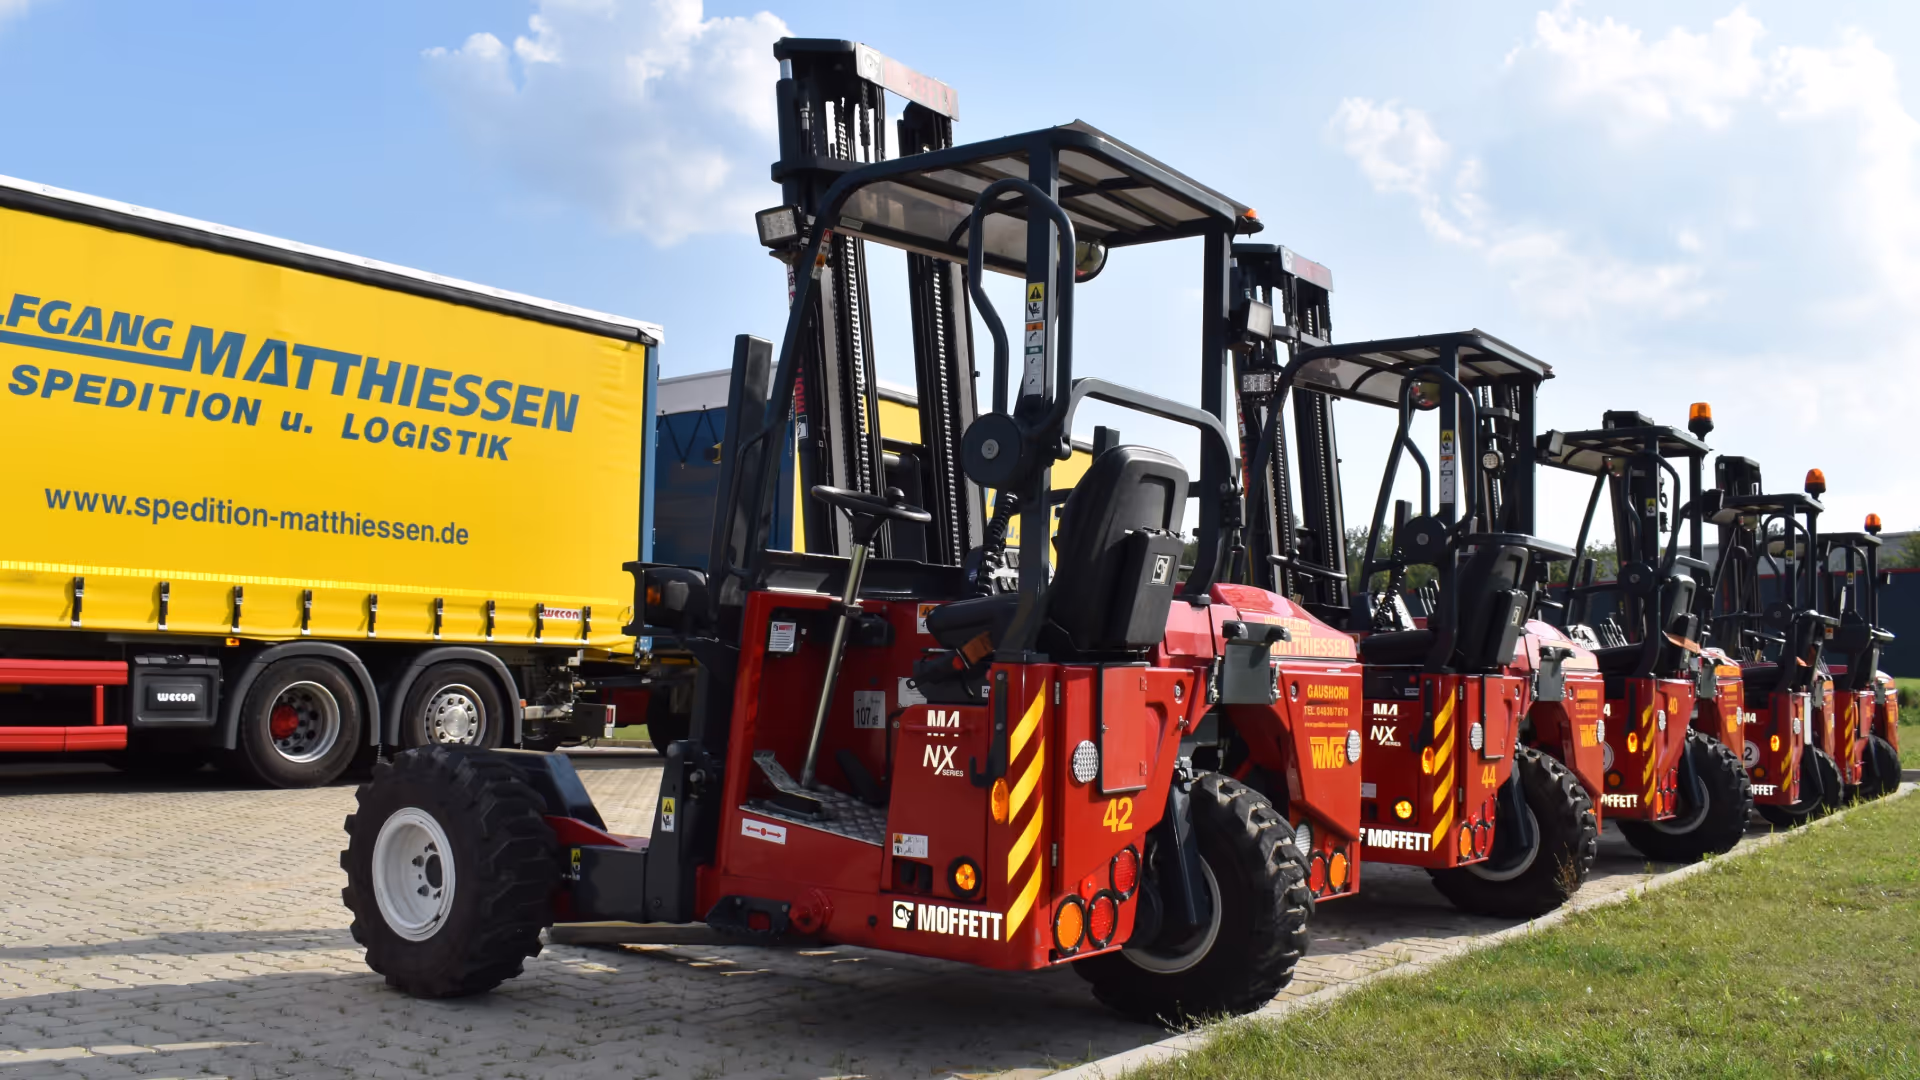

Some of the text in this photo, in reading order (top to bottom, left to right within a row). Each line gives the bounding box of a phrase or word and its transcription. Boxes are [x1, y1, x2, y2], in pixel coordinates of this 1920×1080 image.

[0, 293, 580, 433] FGANG MATTHIESSEN
[8, 364, 513, 461] SPEDITION u. LOGISTIK
[45, 488, 469, 545] www.spedition-matthiessen.de
[544, 609, 579, 619] wecon
[157, 693, 196, 702] wecon
[1307, 684, 1349, 700] GAUSHORN
[856, 706, 871, 726] 107
[1370, 725, 1397, 746] NX
[923, 744, 958, 775] NX
[1310, 737, 1346, 769] WMG
[942, 768, 964, 777] SERIES
[1481, 765, 1497, 788] 44
[1103, 797, 1133, 833] 42
[1367, 828, 1432, 852] MOFFETT
[917, 903, 1003, 941] MOFFETT
